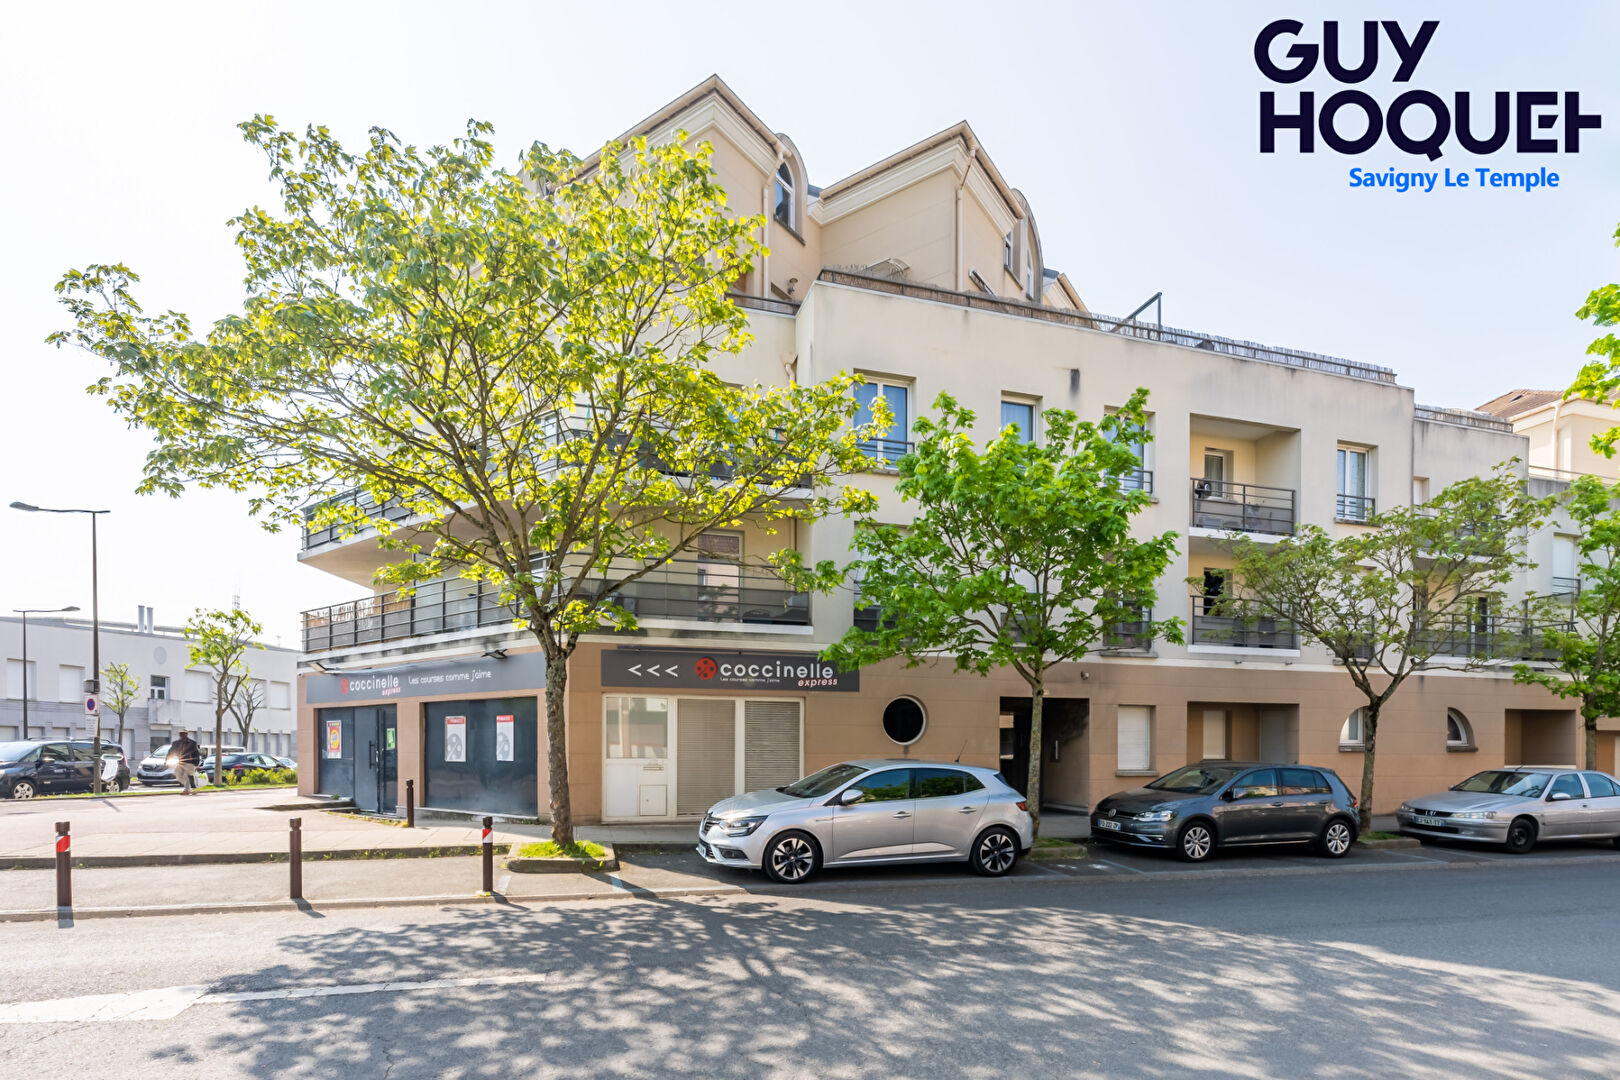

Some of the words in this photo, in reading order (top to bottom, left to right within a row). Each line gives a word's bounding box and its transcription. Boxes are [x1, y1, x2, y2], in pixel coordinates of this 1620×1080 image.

[720, 660, 834, 678] coccinelle
[350, 674, 399, 691] coccinelle
[408, 675, 419, 685] Les
[420, 674, 444, 684] courses
[446, 672, 470, 681] comme
[797, 678, 838, 688] express
